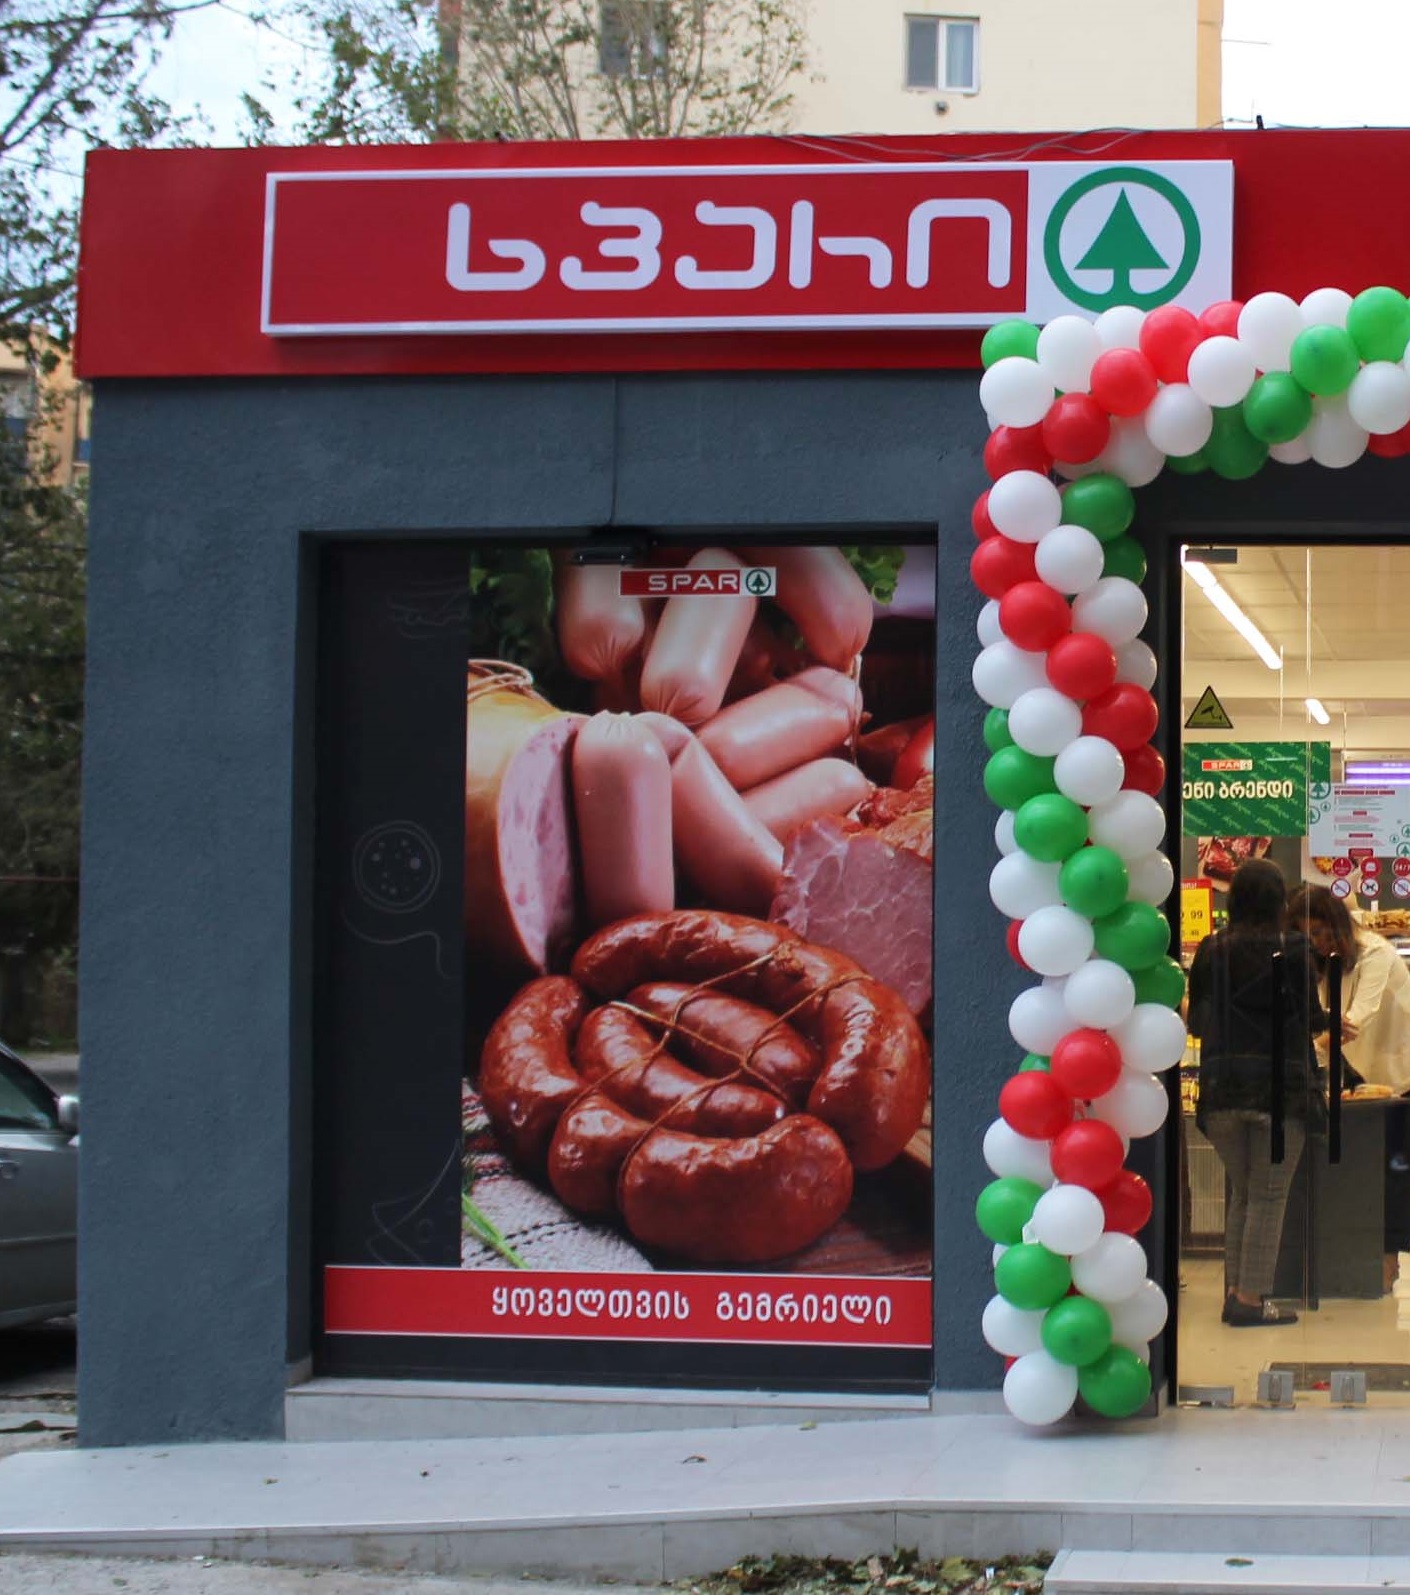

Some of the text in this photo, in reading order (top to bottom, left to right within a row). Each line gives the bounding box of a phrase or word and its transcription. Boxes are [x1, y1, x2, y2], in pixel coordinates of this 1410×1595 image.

[445, 199, 1012, 291] სპარი
[648, 573, 738, 592] SPAR
[1211, 761, 1240, 770] SPAR
[1219, 780, 1292, 798] ბრენდი
[492, 1286, 891, 1325] ყოველთვის გემრიელი
